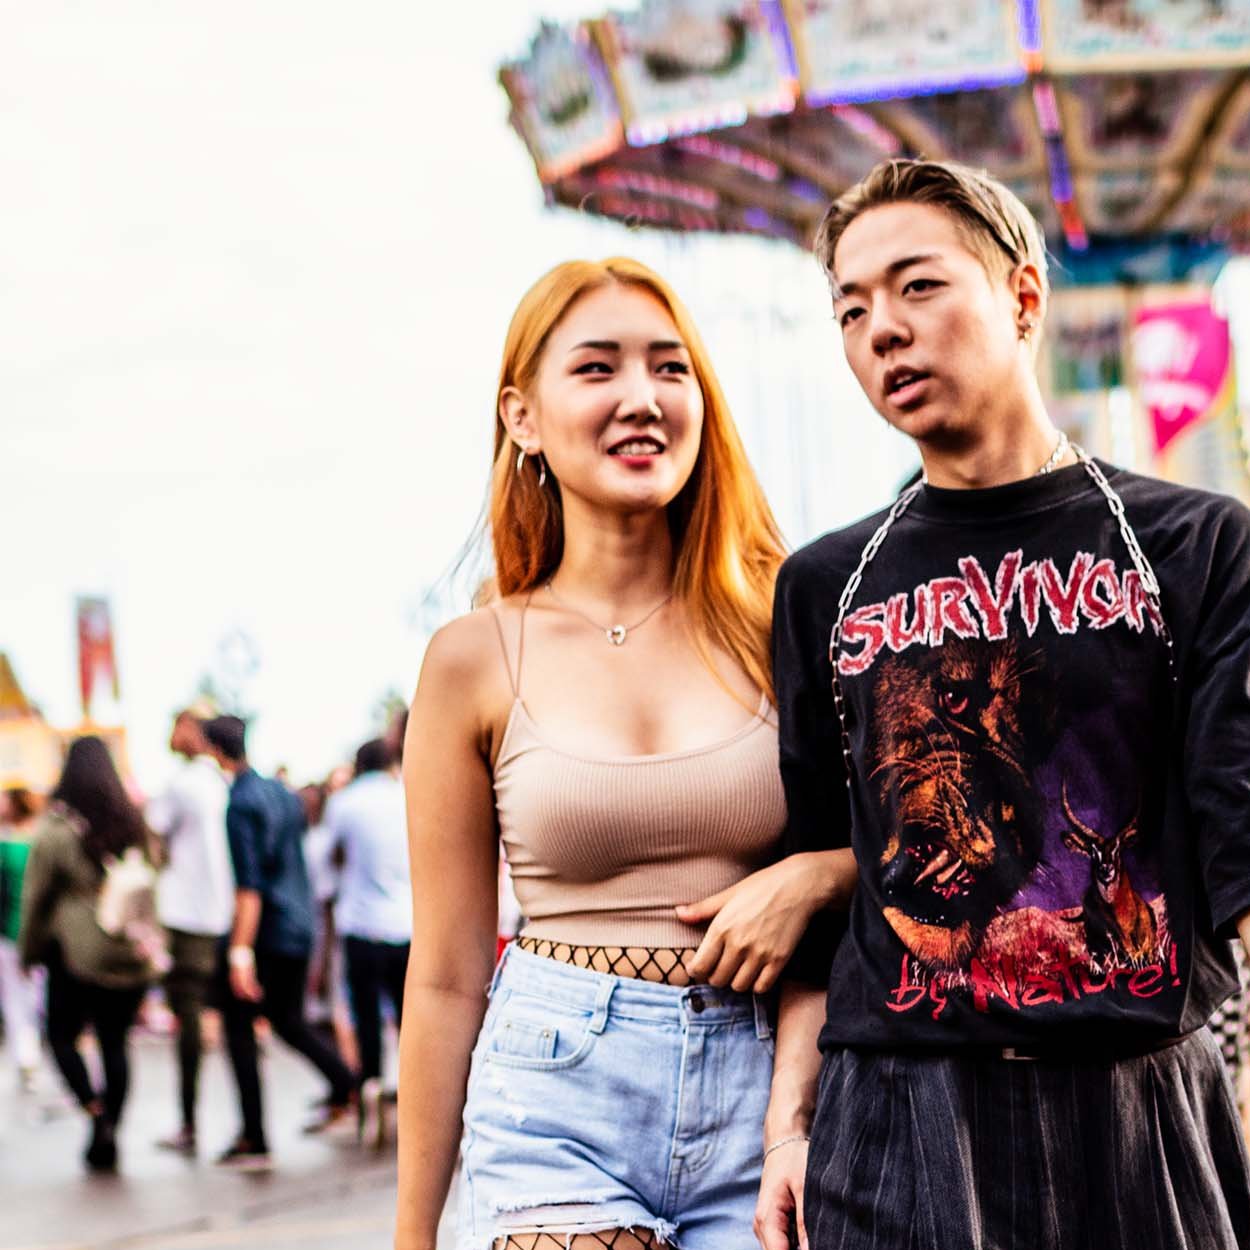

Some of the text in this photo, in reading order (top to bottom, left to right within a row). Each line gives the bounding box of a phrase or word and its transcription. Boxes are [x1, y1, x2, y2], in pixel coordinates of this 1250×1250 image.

[838, 548, 1162, 675] SURVIVOR
[885, 942, 1182, 1021] by Nature!
